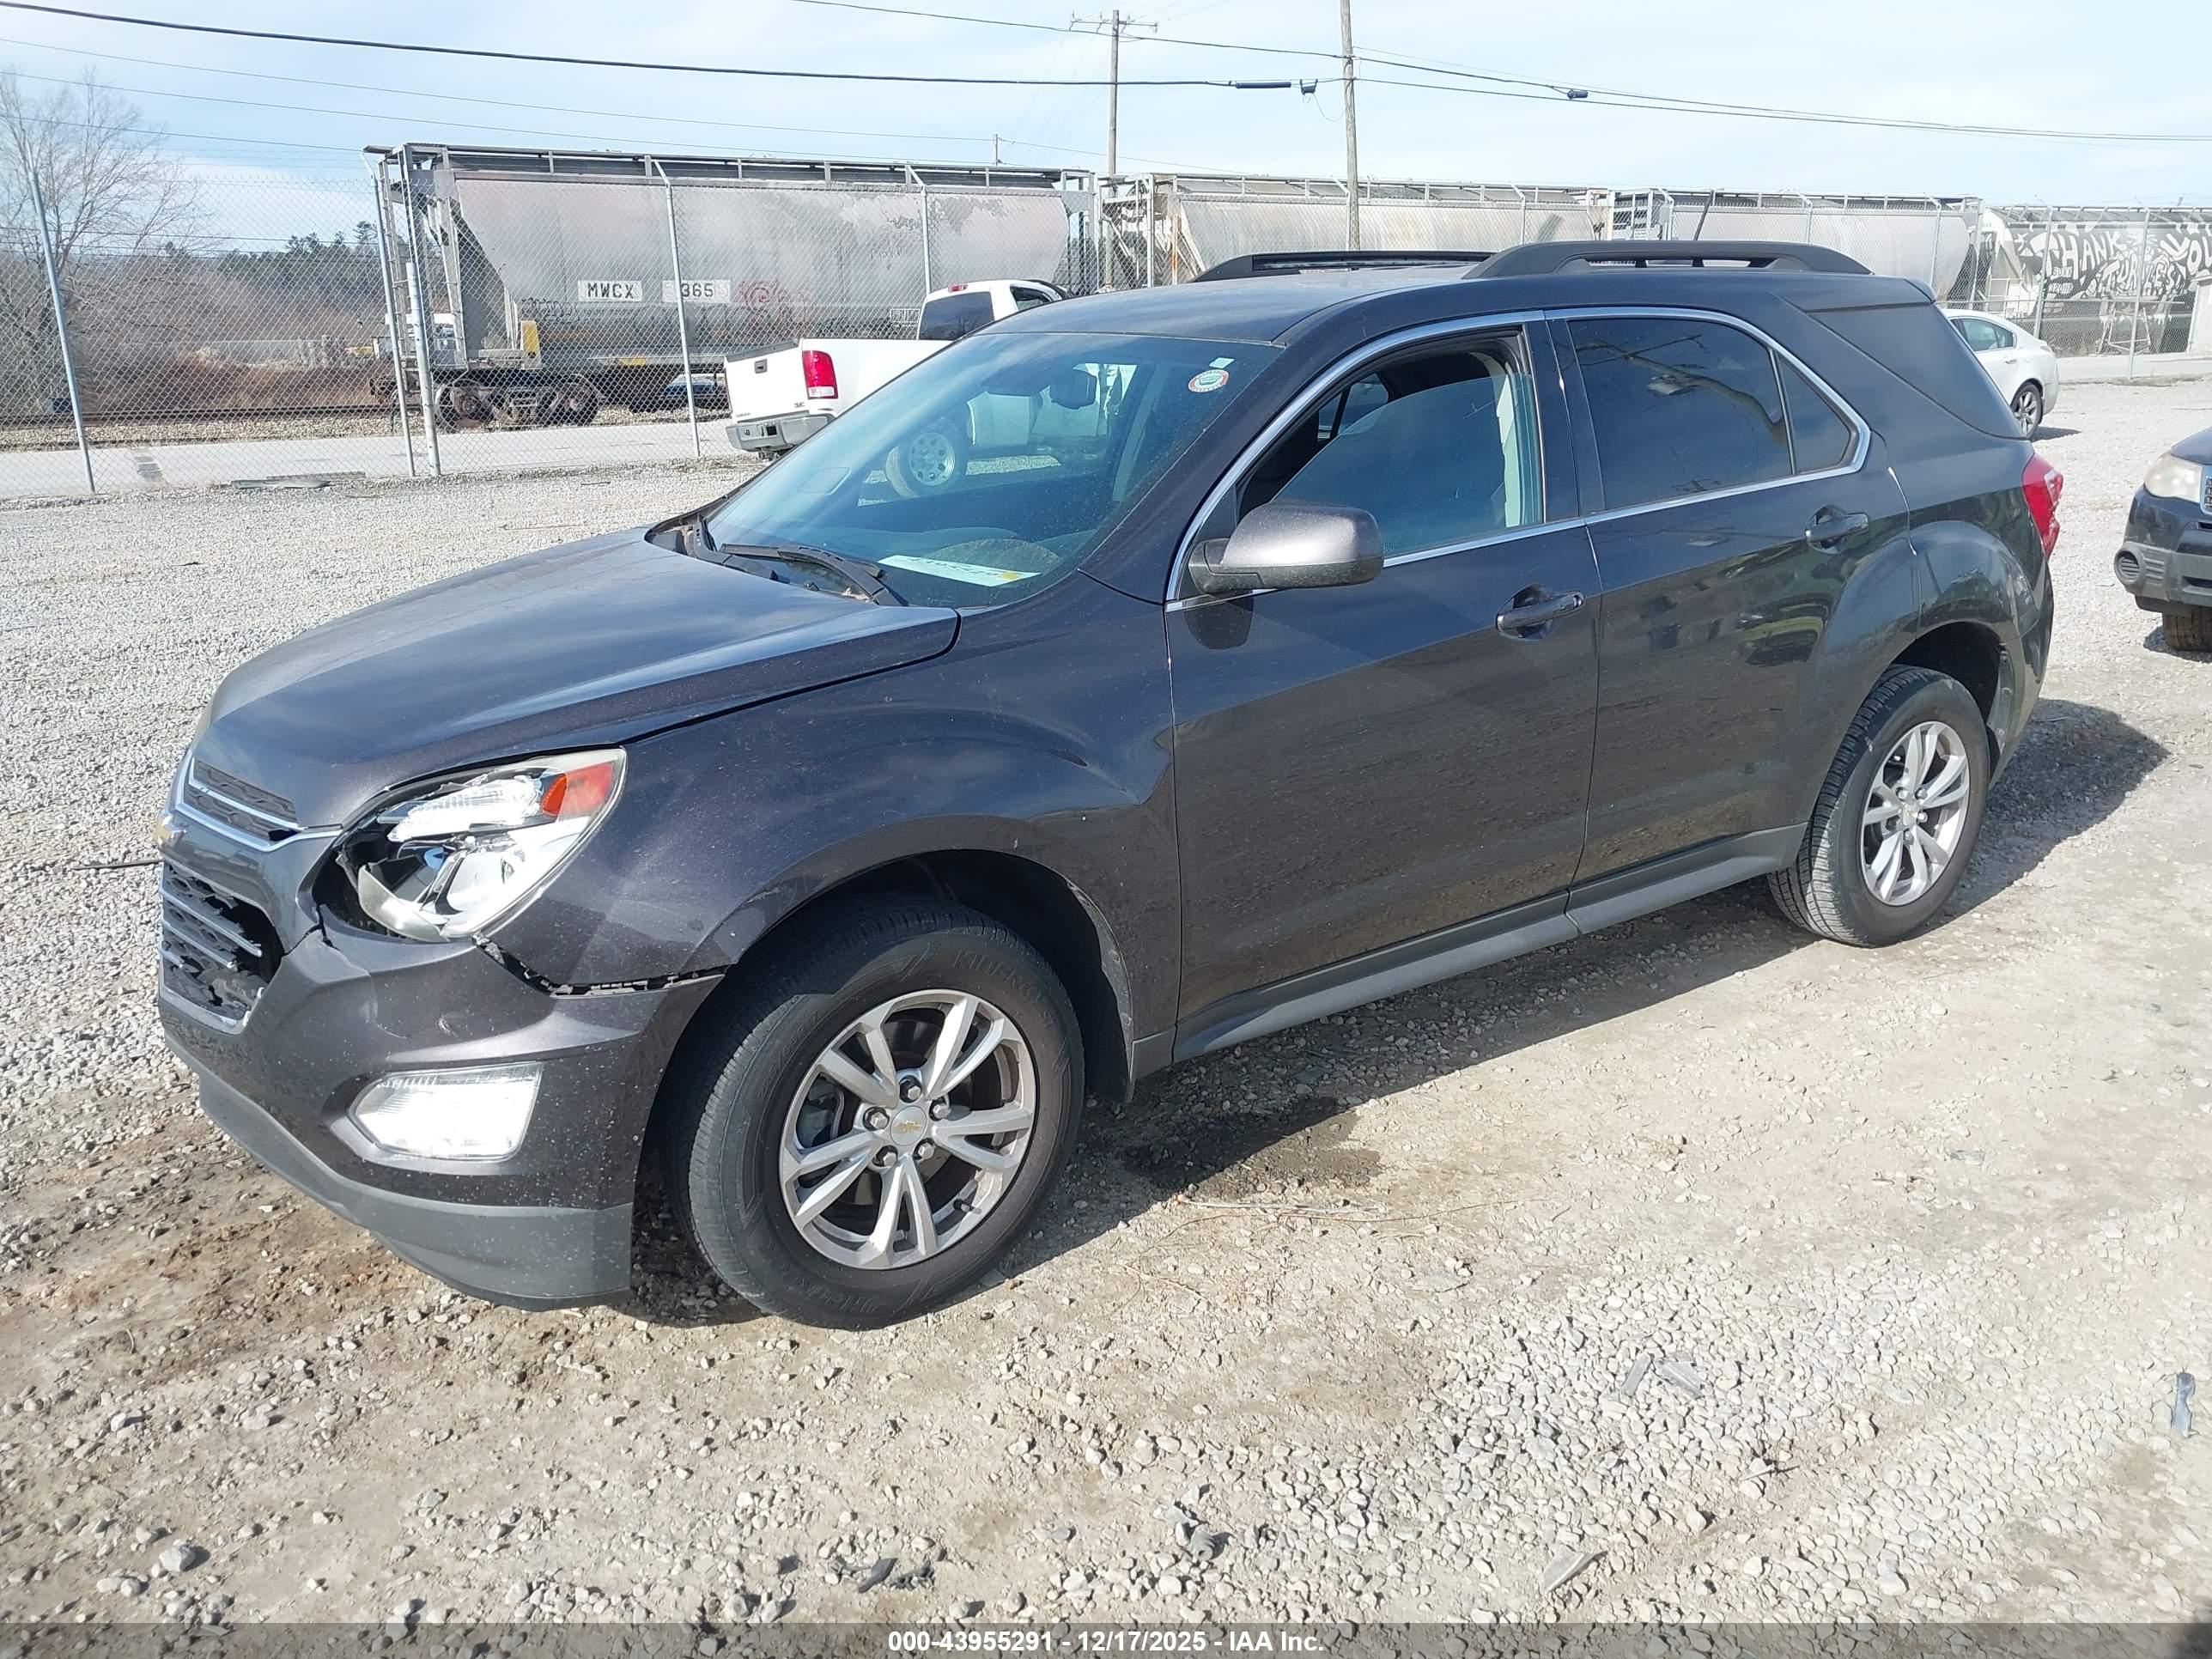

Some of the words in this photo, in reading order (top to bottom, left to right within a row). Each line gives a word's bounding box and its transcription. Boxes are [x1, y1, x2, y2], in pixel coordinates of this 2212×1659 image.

[2030, 230, 2127, 279] THANK
[587, 282, 635, 299] MWCX
[2100, 255, 2176, 292] TURLES
